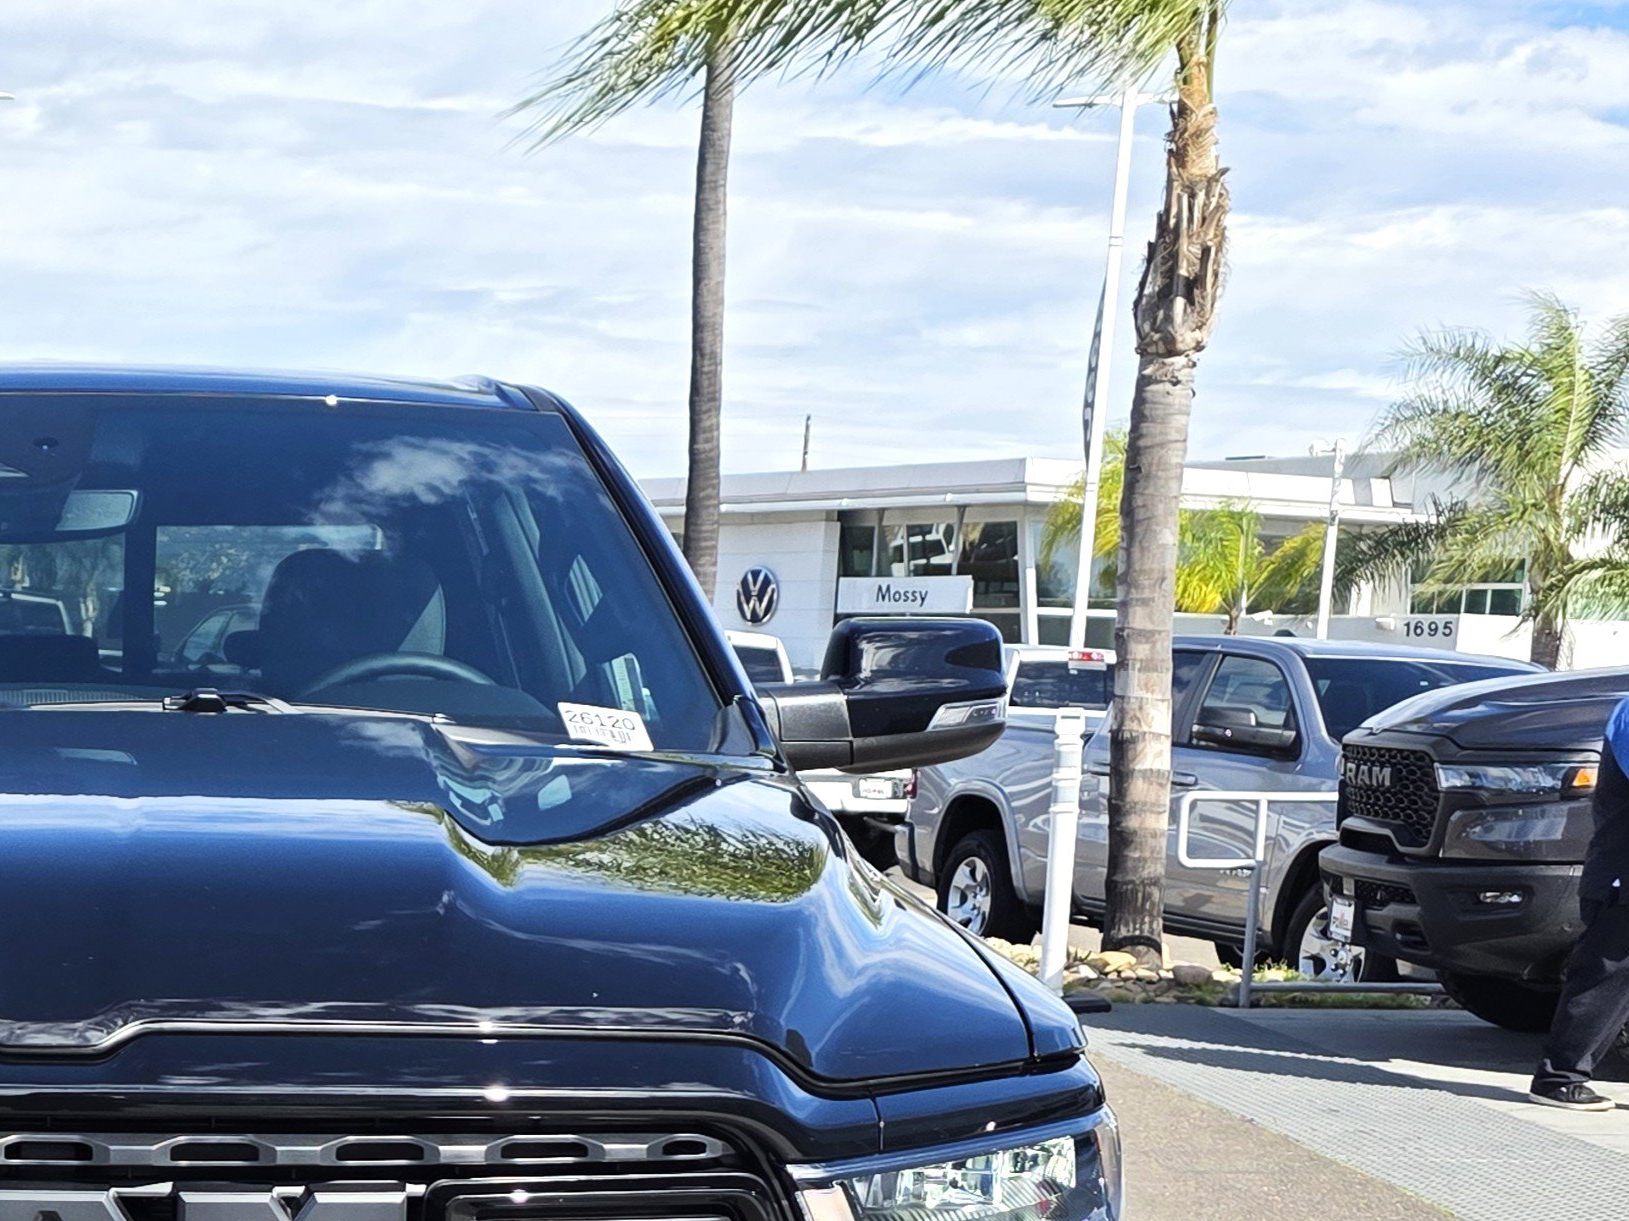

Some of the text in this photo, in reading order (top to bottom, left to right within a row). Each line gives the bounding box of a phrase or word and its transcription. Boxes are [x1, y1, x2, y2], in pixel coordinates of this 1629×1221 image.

[875, 583, 929, 607] Mossy
[1403, 620, 1454, 638] 1695
[565, 709, 636, 731] 26120
[1345, 762, 1392, 787] RAM
